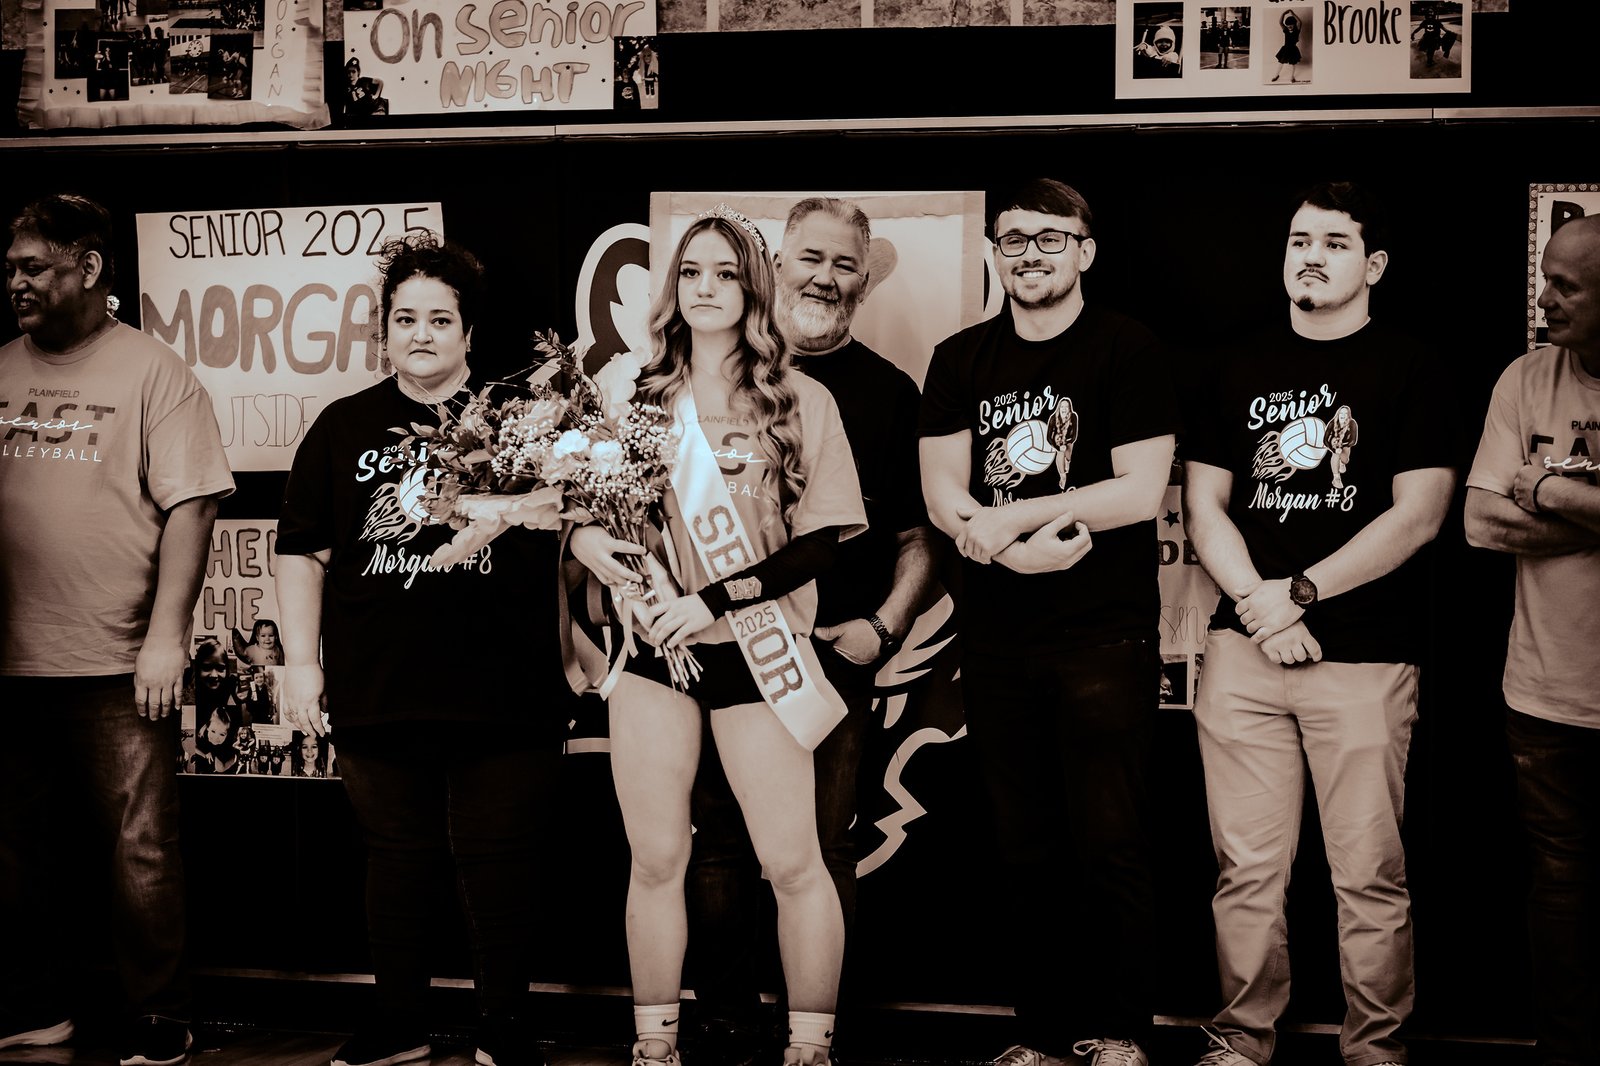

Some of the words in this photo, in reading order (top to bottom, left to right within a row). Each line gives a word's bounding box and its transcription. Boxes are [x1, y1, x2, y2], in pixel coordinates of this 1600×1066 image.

[1323, 0, 1402, 45] Brooke
[440, 59, 590, 108] NIGHT
[169, 209, 286, 259] SENIOR
[141, 283, 392, 376] MORGA
[28, 388, 80, 398] PLAINFIELD
[978, 385, 1060, 436] Senior
[994, 390, 1018, 407] 2025
[1247, 383, 1338, 431] Senior
[1269, 389, 1294, 403] 2025
[0, 401, 116, 446] AST
[0, 416, 93, 431] enior
[3, 445, 103, 462] LLEYBALL
[1247, 481, 1323, 523] Morgan
[1324, 484, 1358, 512] #8
[736, 605, 777, 639] 2025
